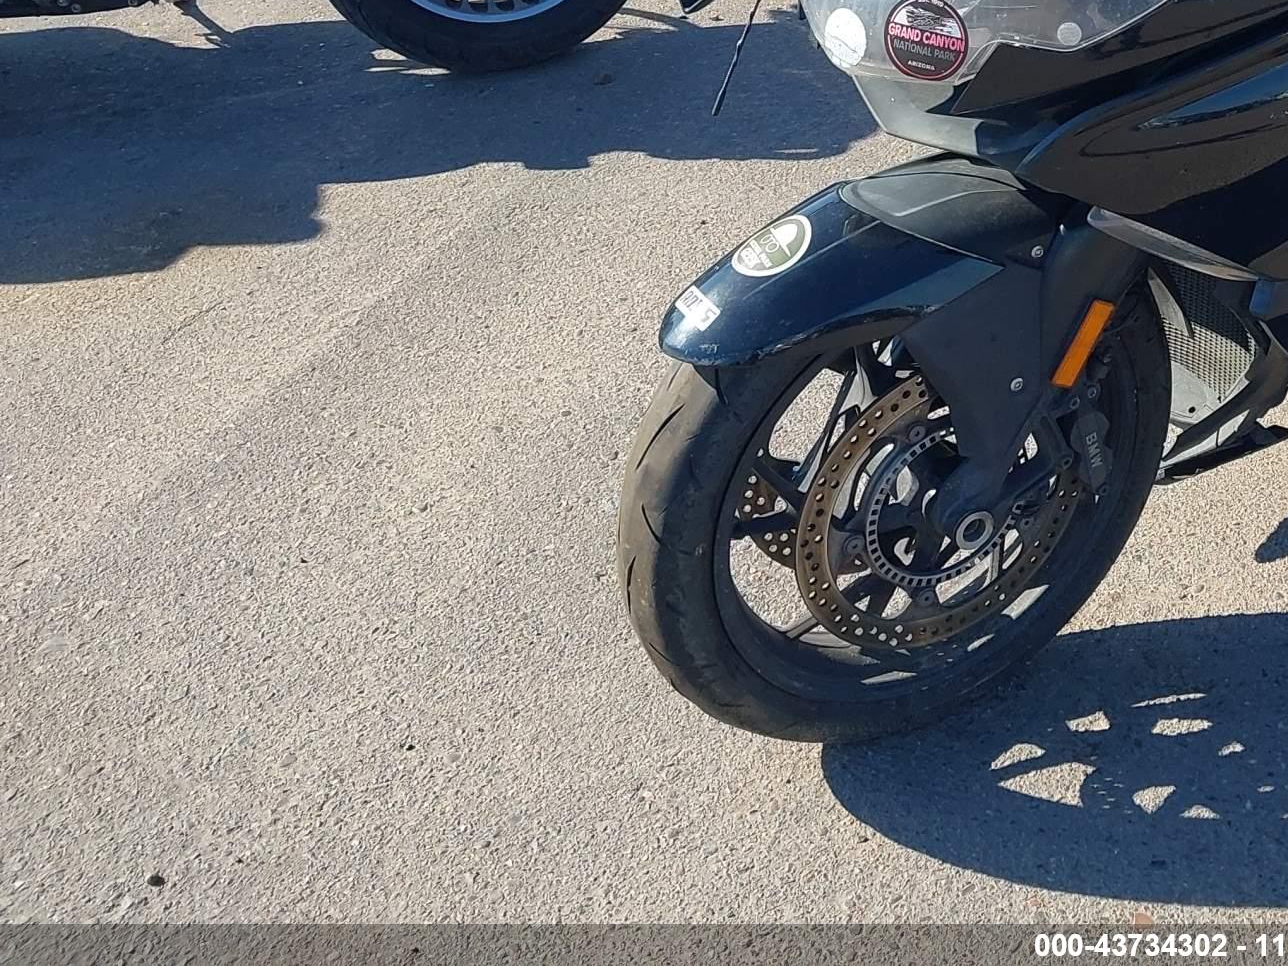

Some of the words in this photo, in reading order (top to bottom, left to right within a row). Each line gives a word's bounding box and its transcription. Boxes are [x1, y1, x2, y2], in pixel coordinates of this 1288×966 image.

[888, 22, 921, 42] GRAND
[922, 31, 965, 53] CANYON
[893, 38, 932, 57] NATIONAL
[933, 48, 955, 62] PARK
[907, 59, 935, 71] ARIZONA
[1085, 431, 1103, 468] BMW
